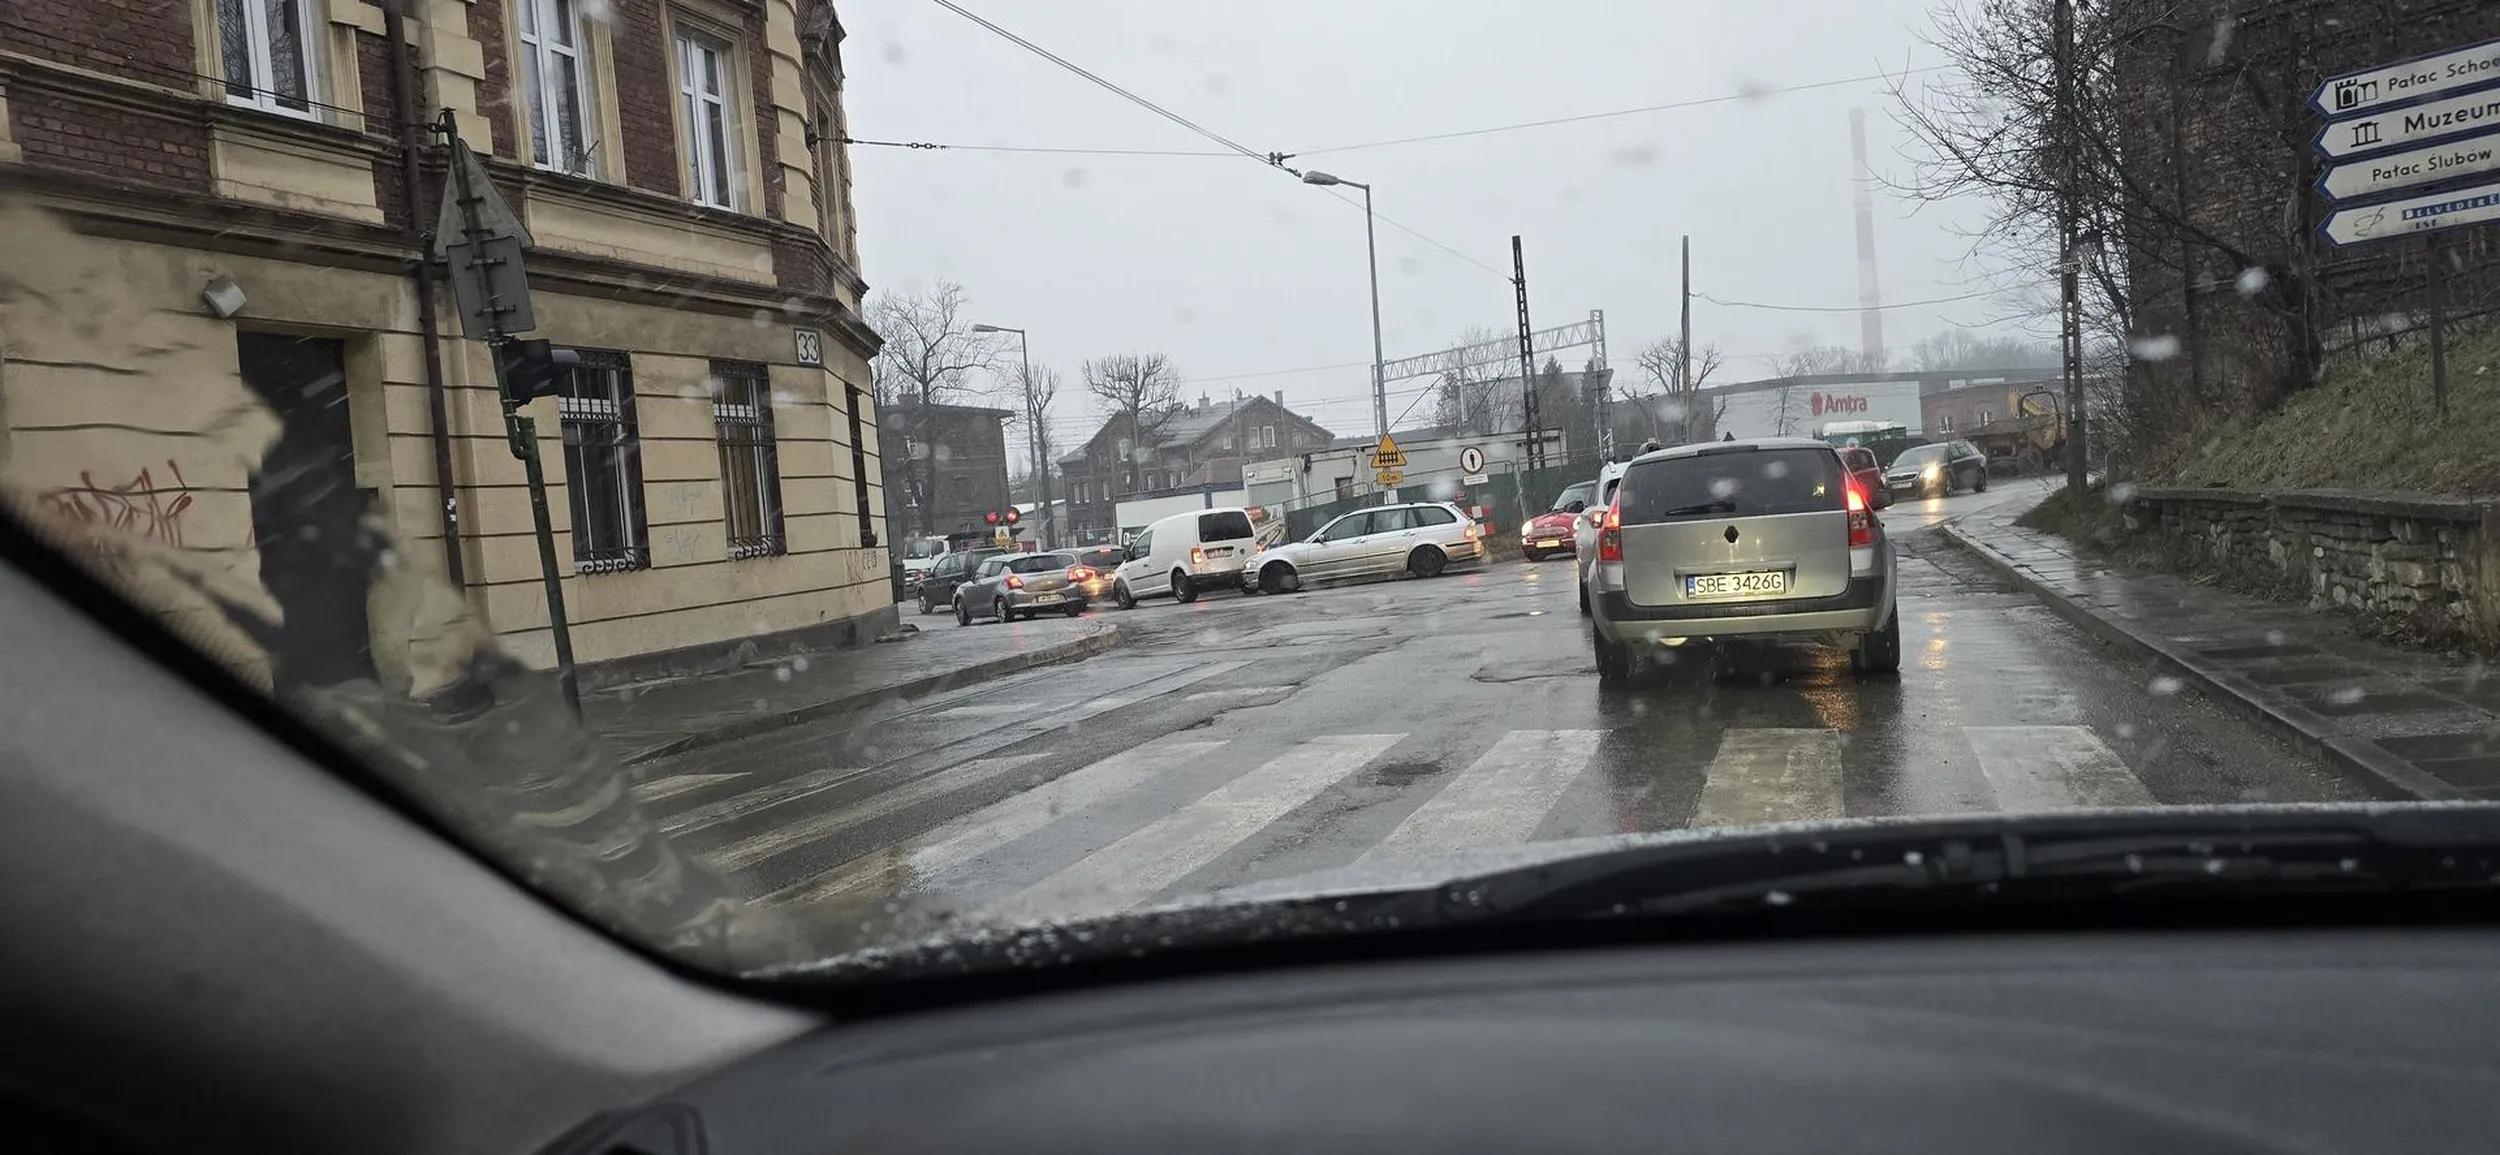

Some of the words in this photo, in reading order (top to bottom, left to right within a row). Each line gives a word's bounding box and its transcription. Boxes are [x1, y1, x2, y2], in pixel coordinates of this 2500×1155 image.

[2388, 72, 2438, 91] Pałac
[2372, 163, 2420, 182] Pałac
[2427, 149, 2492, 171] Ślubów
[2405, 194, 2497, 219] BELVEDERE
[798, 333, 818, 362] 33
[1825, 394, 1867, 414] Amtra
[1696, 577, 1727, 593] SBE
[1732, 574, 1782, 591] 3426G
